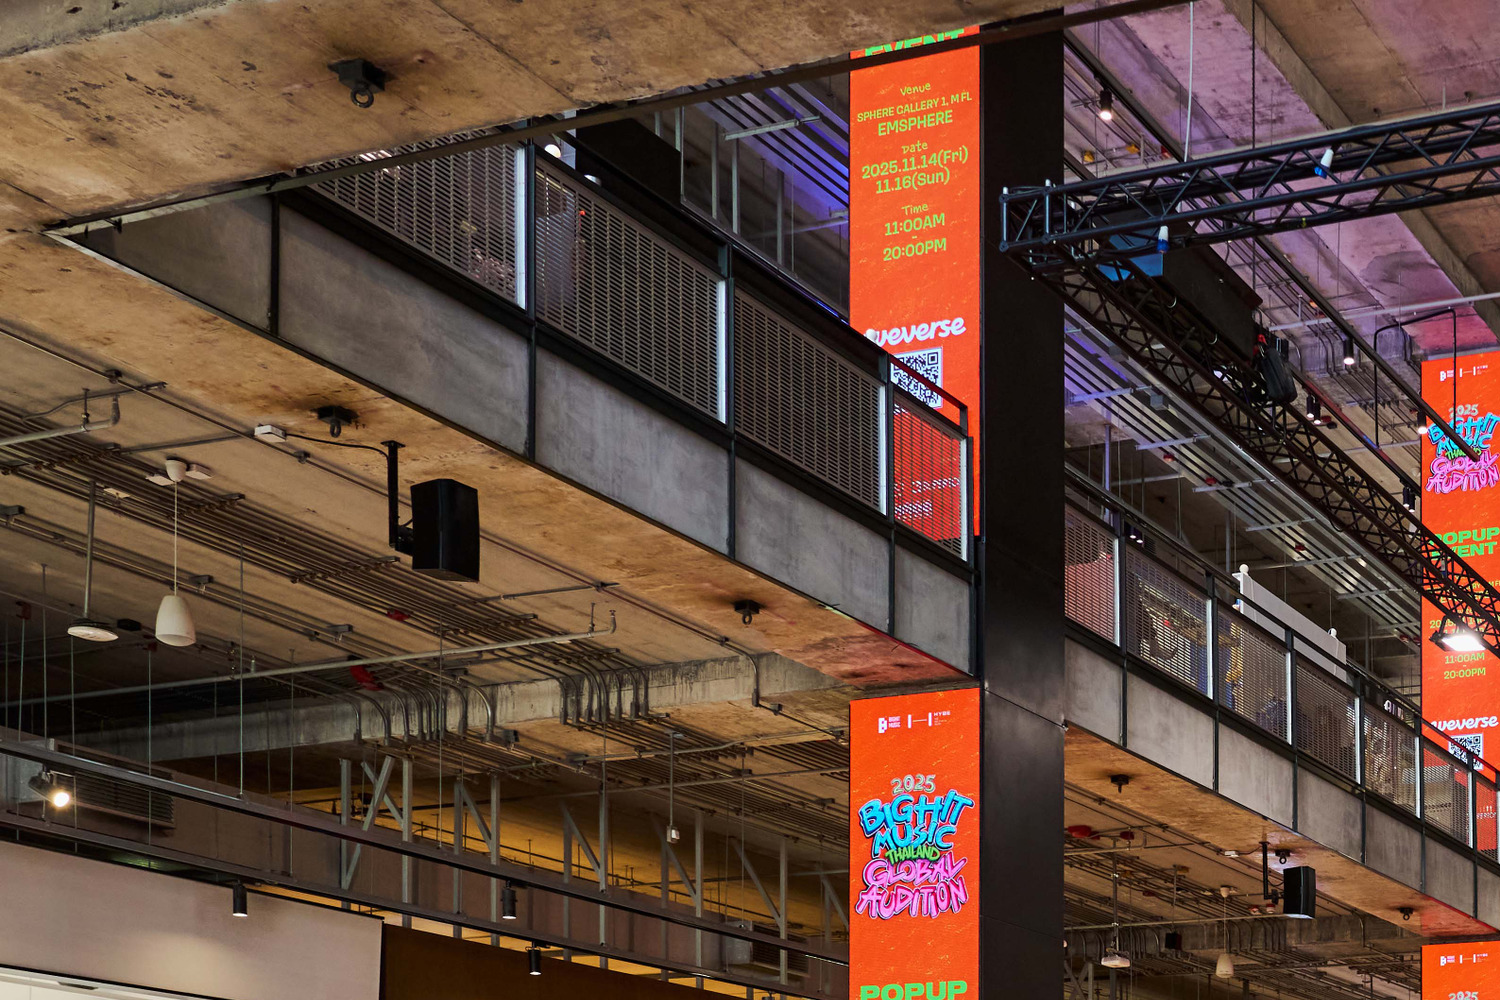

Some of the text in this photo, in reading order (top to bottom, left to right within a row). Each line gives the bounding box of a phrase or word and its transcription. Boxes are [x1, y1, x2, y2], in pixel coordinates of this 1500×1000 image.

[900, 83, 931, 96] Venue
[857, 107, 895, 122] SPHERE
[897, 98, 939, 115] GALLERY
[950, 94, 959, 104] M
[961, 92, 972, 102] FL
[878, 110, 953, 136] EMSPHERE
[902, 140, 928, 154] Date
[862, 145, 968, 179] 2025.11.14(Fri)
[876, 167, 950, 194] 11.16(Sun)
[902, 203, 929, 216] Time
[885, 213, 945, 236] 11:00AM
[883, 238, 946, 261] 20:00PM
[1426, 465, 1500, 494] AUDITION
[1445, 653, 1485, 664] 11:00AM
[1444, 668, 1486, 679] 20:00PM
[891, 774, 936, 795] 2025
[872, 821, 956, 859] MUSIC
[885, 846, 940, 864] THAILAND
[863, 852, 968, 888] GLOBAL
[855, 876, 969, 919] AUDITION
